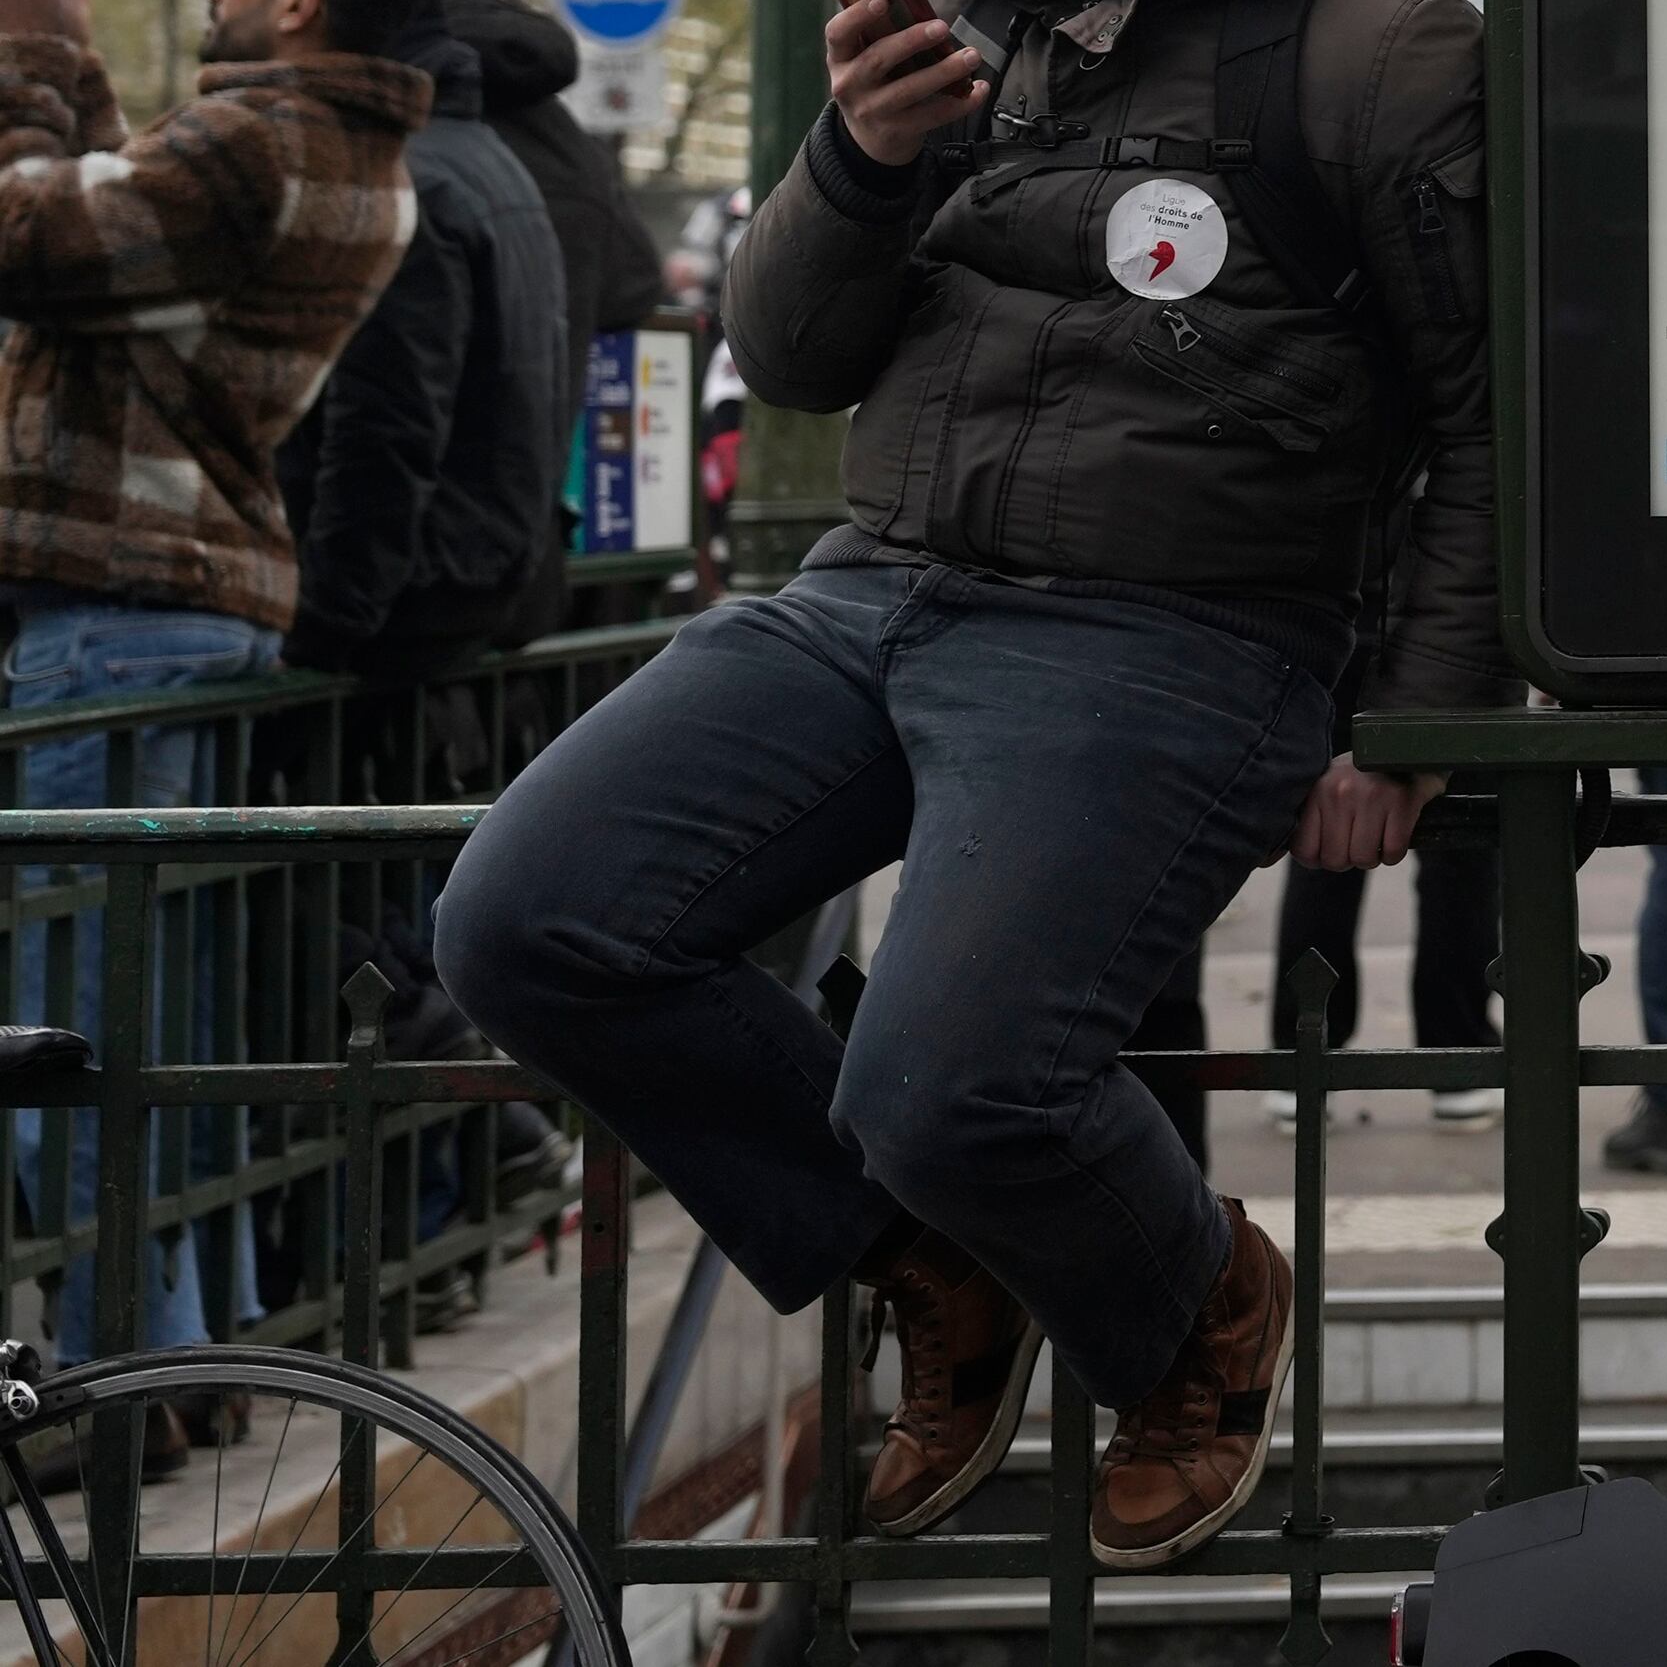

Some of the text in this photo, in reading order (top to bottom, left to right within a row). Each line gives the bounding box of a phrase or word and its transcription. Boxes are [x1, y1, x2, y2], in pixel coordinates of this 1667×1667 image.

[1162, 193, 1186, 206] Ligue
[1140, 202, 1203, 221] des droits de
[1148, 214, 1190, 230] l'Homme
